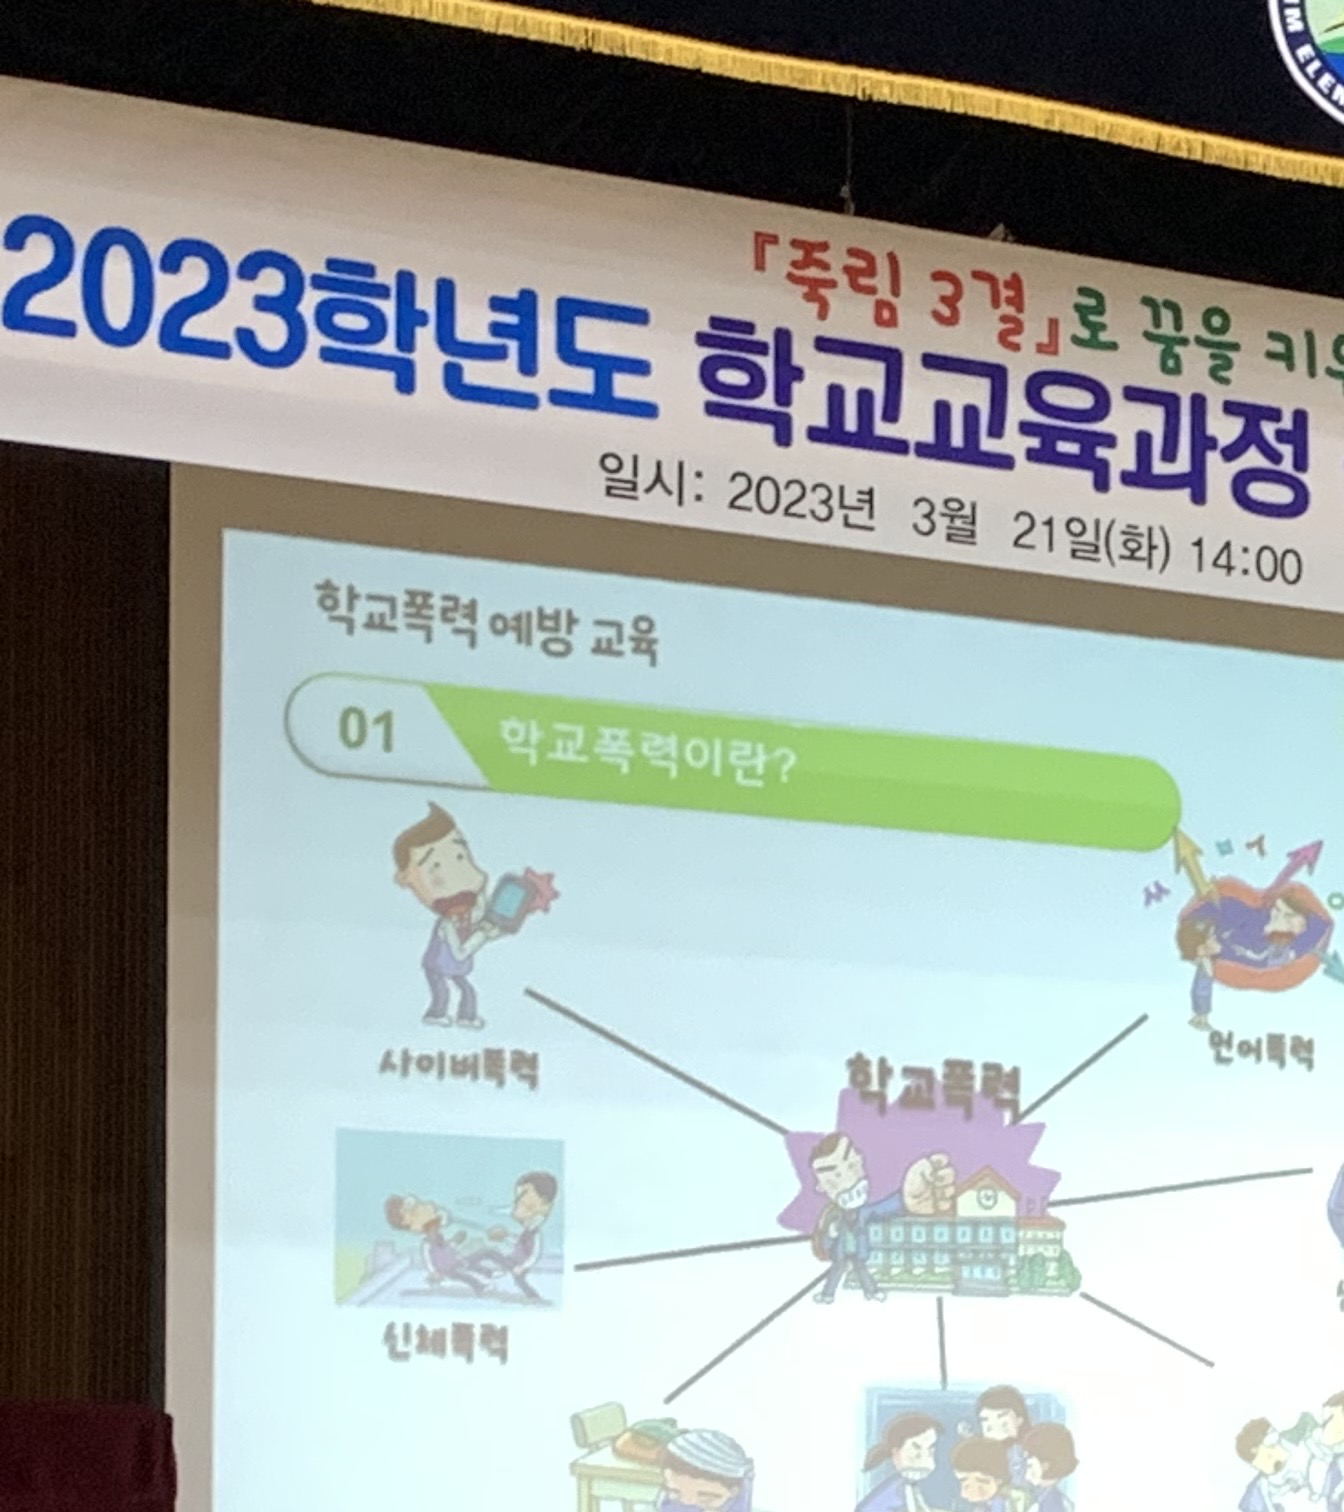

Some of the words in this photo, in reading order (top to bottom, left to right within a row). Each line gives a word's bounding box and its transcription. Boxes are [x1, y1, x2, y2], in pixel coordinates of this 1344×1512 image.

[1, 213, 660, 420] 2023학년도
[694, 312, 1312, 521] 학교교육과정
[1140, 294, 1241, 386] 꿈을
[598, 450, 705, 508] 일시:
[726, 470, 877, 533] 2023년
[910, 495, 979, 547] 3월
[1011, 509, 1172, 575] 21일(화)
[1190, 535, 1305, 587] 14:00
[313, 578, 480, 650] 학교폭력
[488, 604, 580, 659] 예방
[590, 613, 659, 668] 교육
[337, 705, 395, 754] 01
[499, 714, 798, 789] 학교폭력이란?
[378, 1047, 541, 1092] 사이버폭력
[844, 1050, 1022, 1126] 학교폭력
